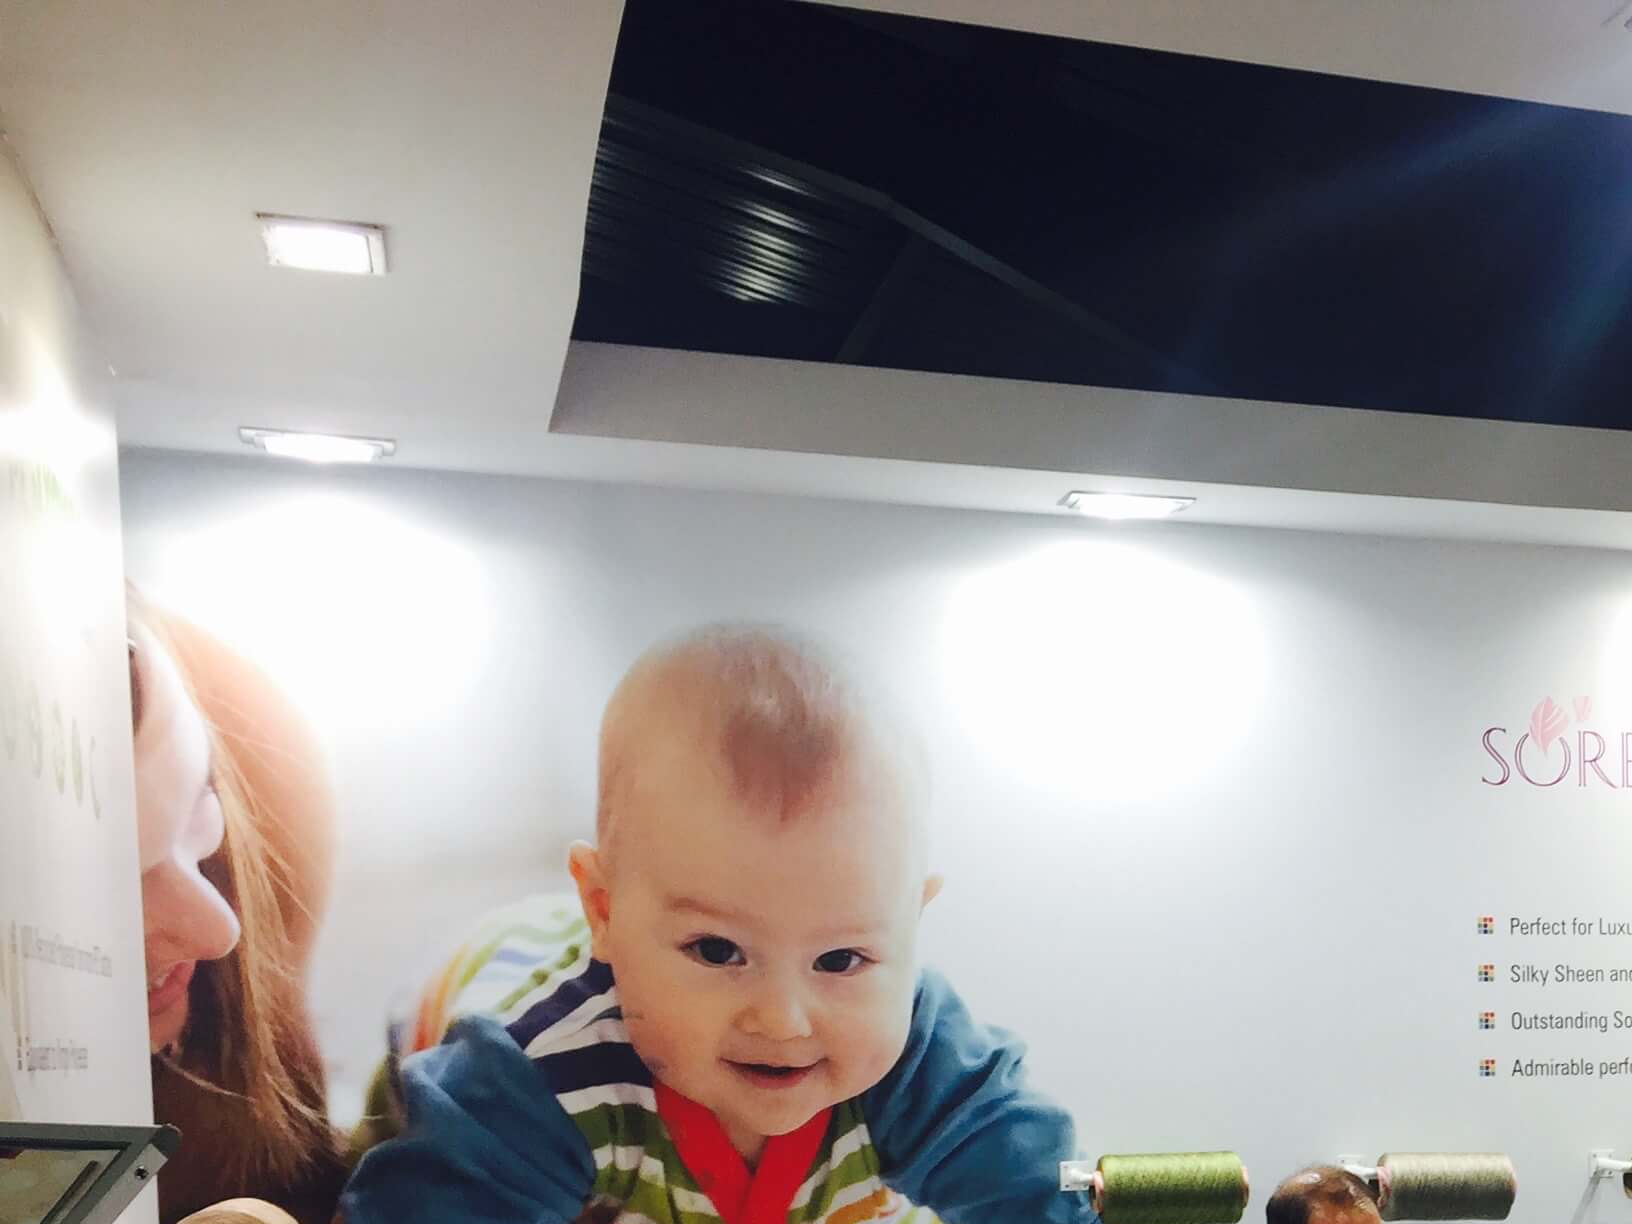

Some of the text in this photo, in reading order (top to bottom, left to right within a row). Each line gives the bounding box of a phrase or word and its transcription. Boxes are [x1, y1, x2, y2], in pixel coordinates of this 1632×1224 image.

[1510, 917, 1566, 937] Perfect
[1571, 917, 1594, 936] for
[1510, 964, 1549, 986] Silky
[1554, 964, 1605, 982] Sheen
[1511, 1012, 1608, 1032] Outstanding
[1511, 1057, 1594, 1077] Admirable
